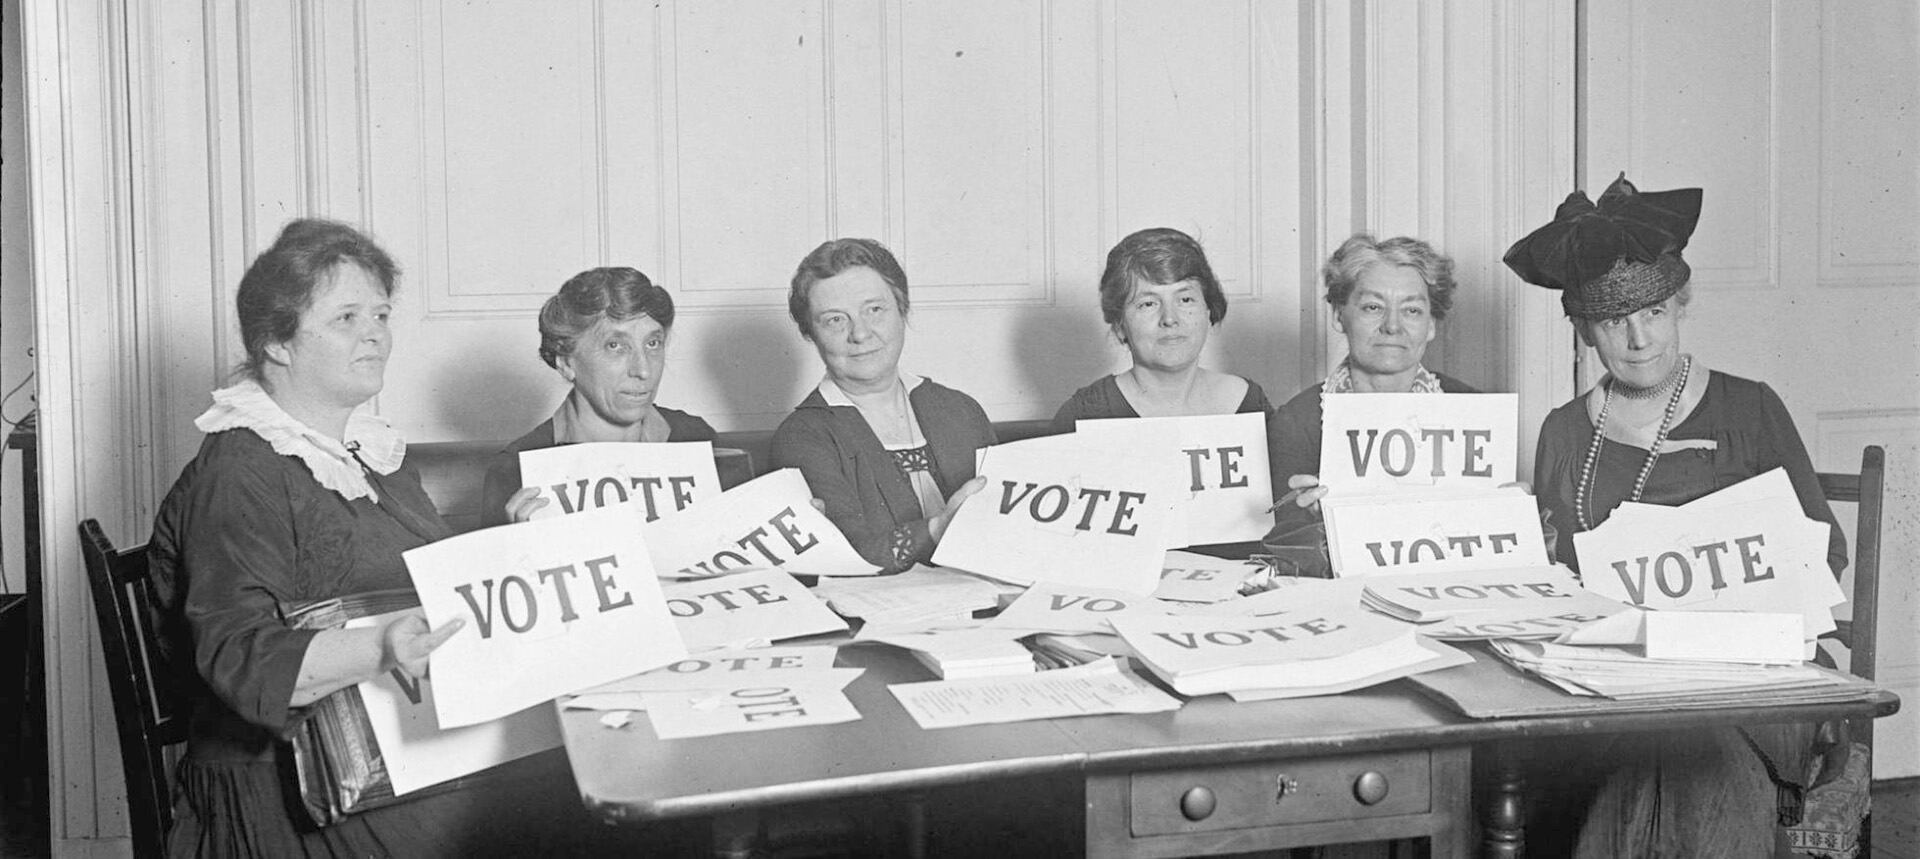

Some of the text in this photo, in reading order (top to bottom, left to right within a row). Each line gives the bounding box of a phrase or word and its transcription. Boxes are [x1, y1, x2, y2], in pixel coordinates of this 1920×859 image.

[1182, 446, 1248, 491] TE
[1346, 429, 1493, 478] VOTE
[999, 480, 1146, 536] VOTE
[1611, 534, 1775, 605] VOTE
[454, 555, 634, 639] VOTE
[666, 584, 788, 617] OTE
[1050, 594, 1127, 612] VO
[1399, 582, 1573, 600] VOTE
[1154, 618, 1347, 649] VOTE
[666, 655, 803, 673] OTE
[730, 687, 807, 722] OTE
